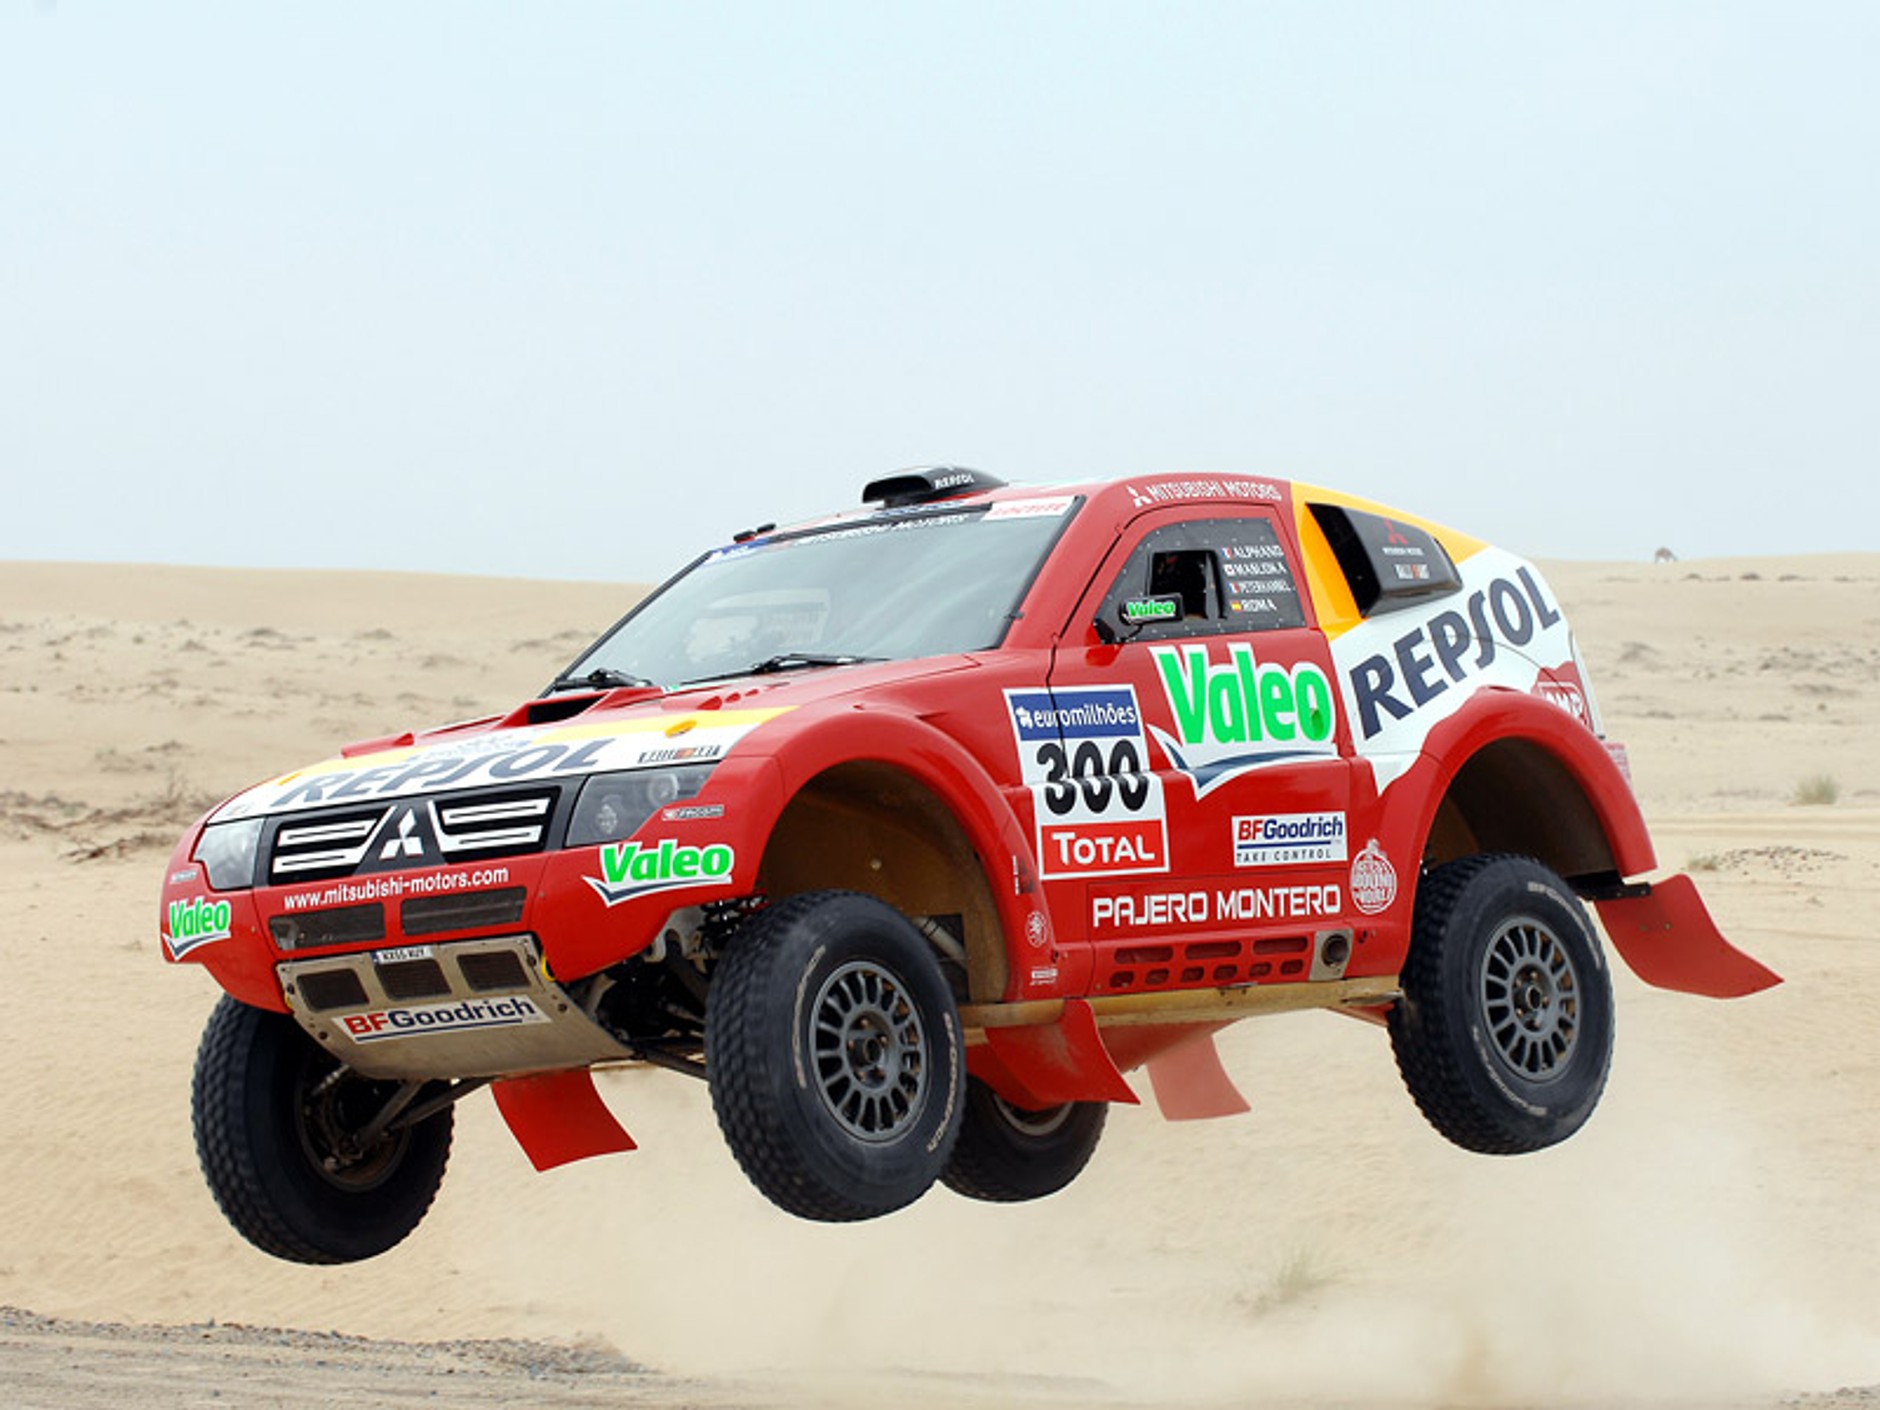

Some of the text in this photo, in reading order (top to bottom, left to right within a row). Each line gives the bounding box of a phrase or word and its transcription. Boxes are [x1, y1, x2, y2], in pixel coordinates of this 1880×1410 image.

[1147, 481, 1283, 501] MITSUBISHI MOTORS
[1127, 600, 1176, 617] Valeo
[1349, 566, 1561, 740] REPSOL
[1157, 650, 1332, 744] Valeo
[270, 738, 616, 807] REPSOL
[1036, 738, 1150, 816] 300
[1238, 816, 1343, 841] BFGoodrich
[603, 841, 731, 883] Valeo
[1236, 848, 1332, 863] TAKE CONTROL
[284, 867, 509, 910] www.mitsubishi-motors.com
[1093, 884, 1341, 928] PAJERO MONTERO
[169, 899, 229, 939] Valeo
[344, 997, 536, 1036] BFGoodrich
